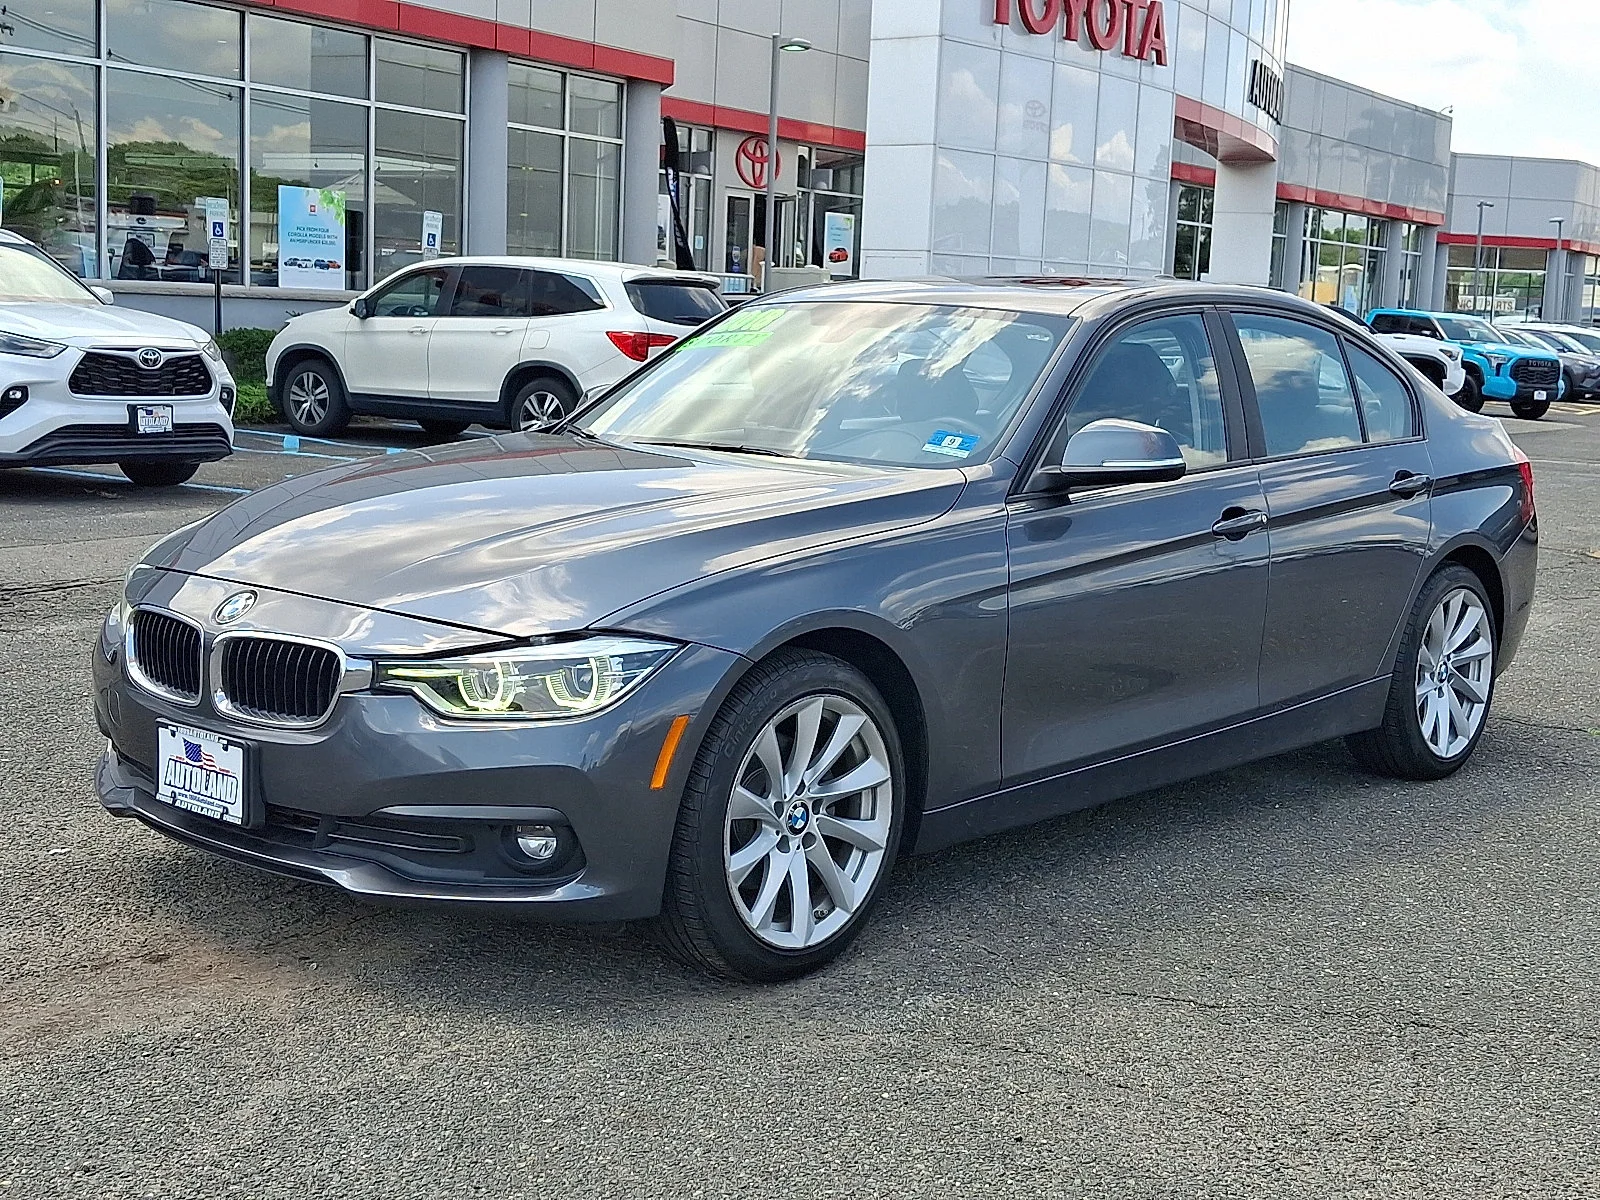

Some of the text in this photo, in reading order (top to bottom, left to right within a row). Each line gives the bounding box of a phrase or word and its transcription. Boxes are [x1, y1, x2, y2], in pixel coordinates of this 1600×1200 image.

[1486, 301, 1513, 310] PRTS
[165, 759, 237, 805] AUTOLAND
[175, 800, 220, 818] AUTOLAND
